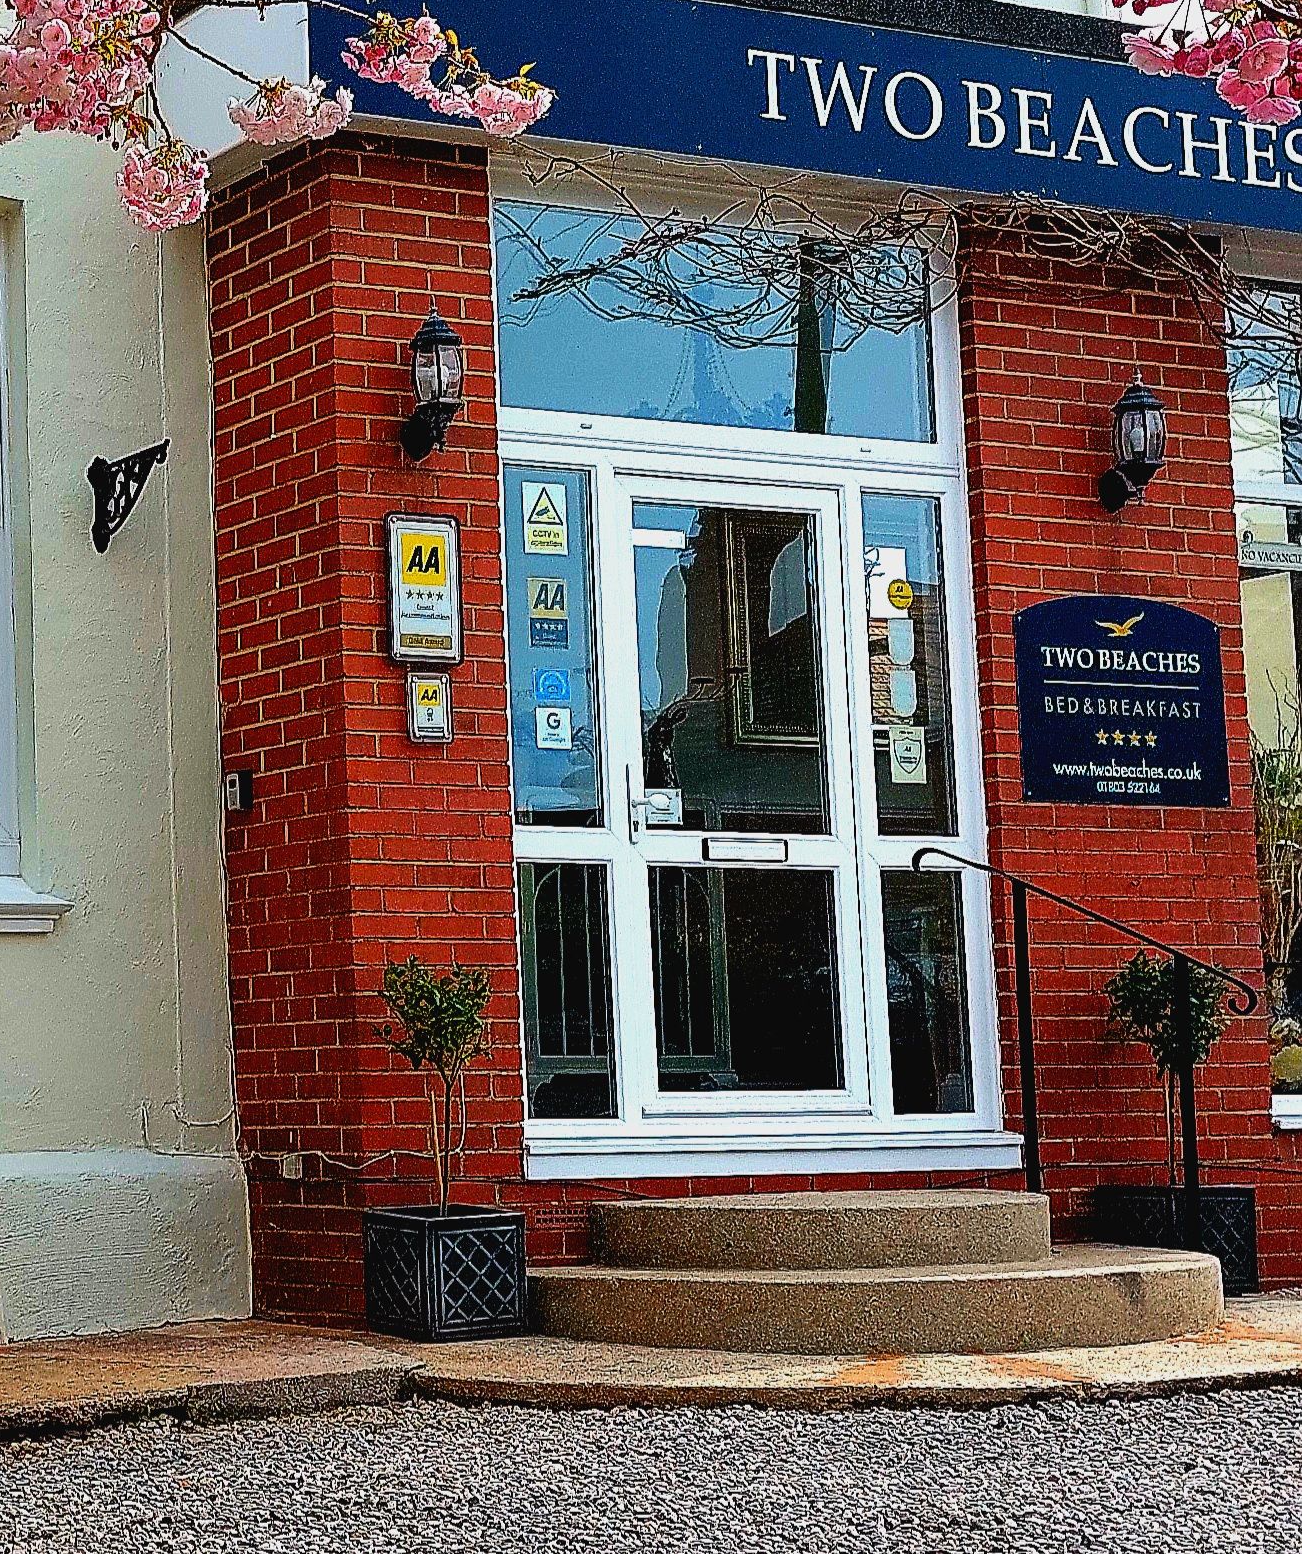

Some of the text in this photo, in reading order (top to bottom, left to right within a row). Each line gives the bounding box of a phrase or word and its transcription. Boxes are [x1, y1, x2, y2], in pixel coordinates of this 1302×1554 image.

[747, 48, 944, 140] TWO
[532, 529, 551, 538] CCTV
[406, 545, 440, 575] AA
[1241, 549, 1256, 561] NO
[532, 583, 565, 612] AA
[1041, 646, 1201, 674] TWO BEACHES
[420, 688, 438, 702] AA
[546, 712, 561, 730] G
[1052, 758, 1202, 781] www.twobeaches.co.uk
